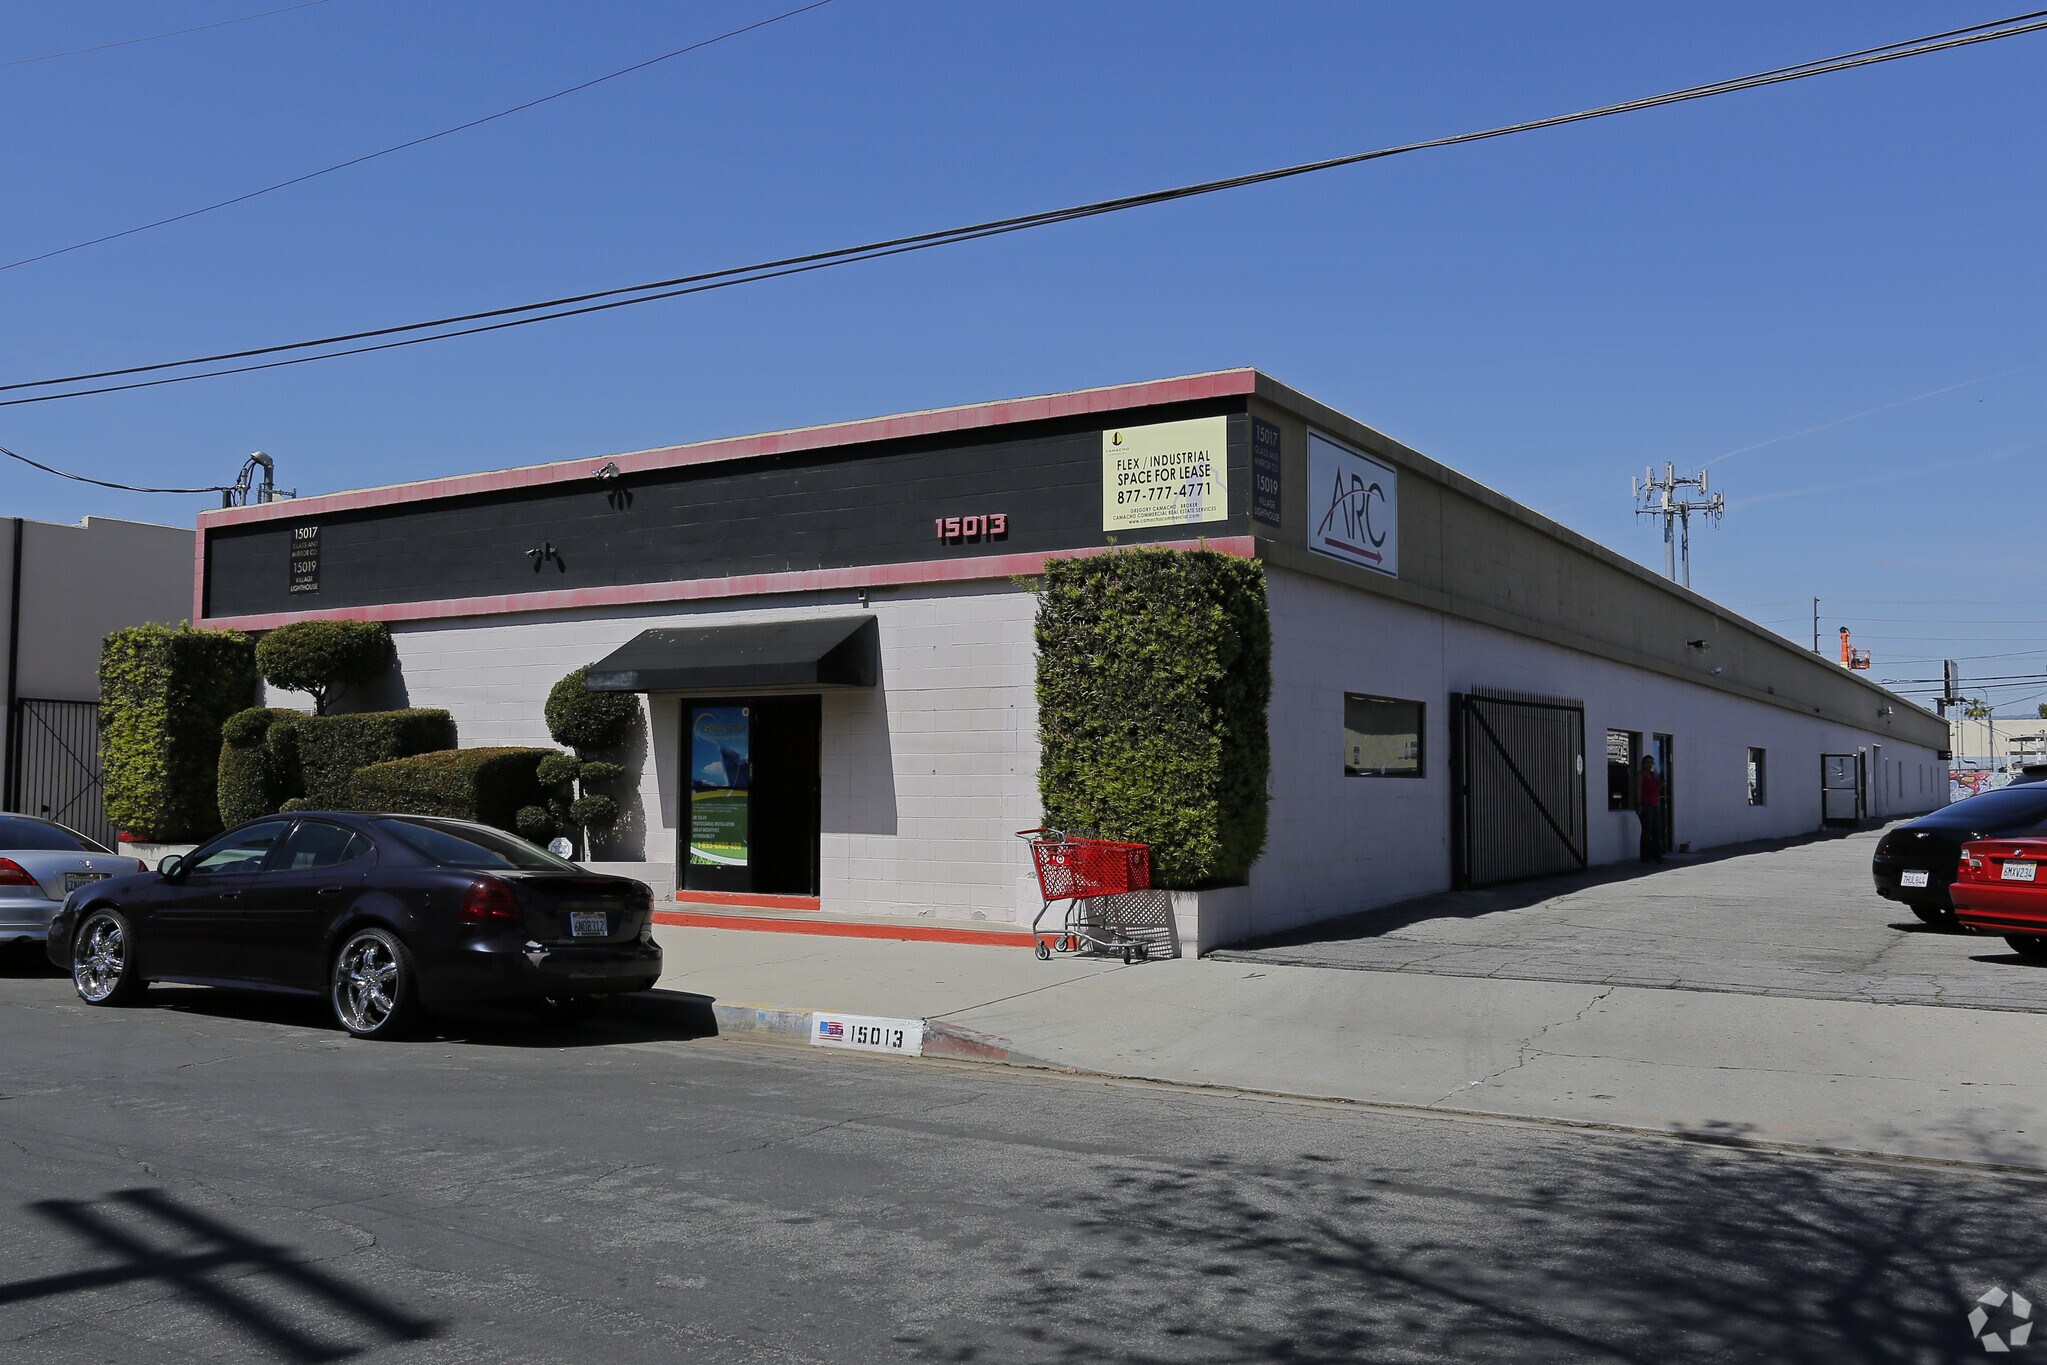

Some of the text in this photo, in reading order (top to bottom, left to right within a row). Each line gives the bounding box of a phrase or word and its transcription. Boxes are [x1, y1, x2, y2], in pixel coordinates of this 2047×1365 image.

[1256, 424, 1277, 447] 15017
[1117, 458, 1140, 471] FLEX
[1150, 450, 1210, 467] INDUSTRIAL
[1117, 464, 1211, 486] SPACE FOR LEASE
[1257, 474, 1278, 496] 15019
[1117, 482, 1211, 504] 877-777-4771
[1259, 496, 1276, 510] VILLAGE
[1137, 510, 1167, 518] COMMERCIAL
[1254, 507, 1280, 523] LIGHTHOUSE
[1328, 465, 1386, 548] ARC
[295, 527, 318, 539] 15017
[936, 513, 1008, 538] 15013
[293, 561, 316, 573] 15019
[290, 583, 318, 592] LIGHTHOUSE
[2003, 867, 2032, 878] 6MXV234
[851, 1025, 903, 1048] 15013
